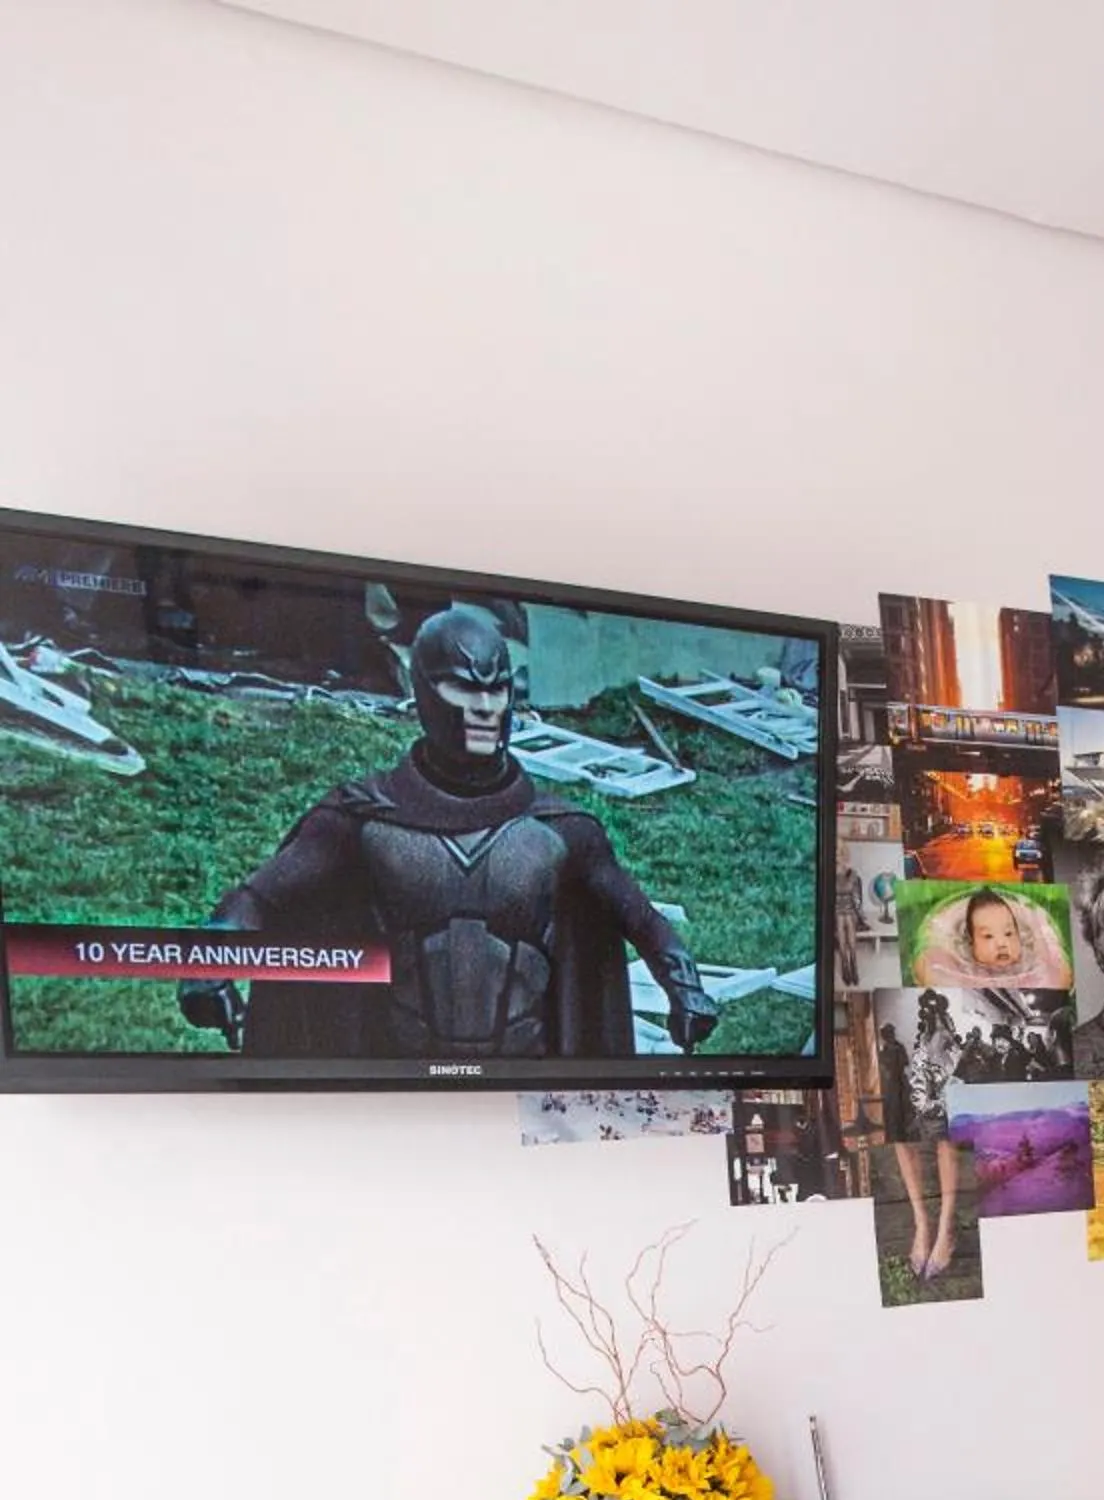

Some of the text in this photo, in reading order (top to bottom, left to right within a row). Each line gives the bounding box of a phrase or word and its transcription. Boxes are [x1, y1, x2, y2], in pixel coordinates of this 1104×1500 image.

[75, 942, 365, 969] 10 YEAR ANNIVERSARY
[429, 1064, 481, 1075] SINOTEC
